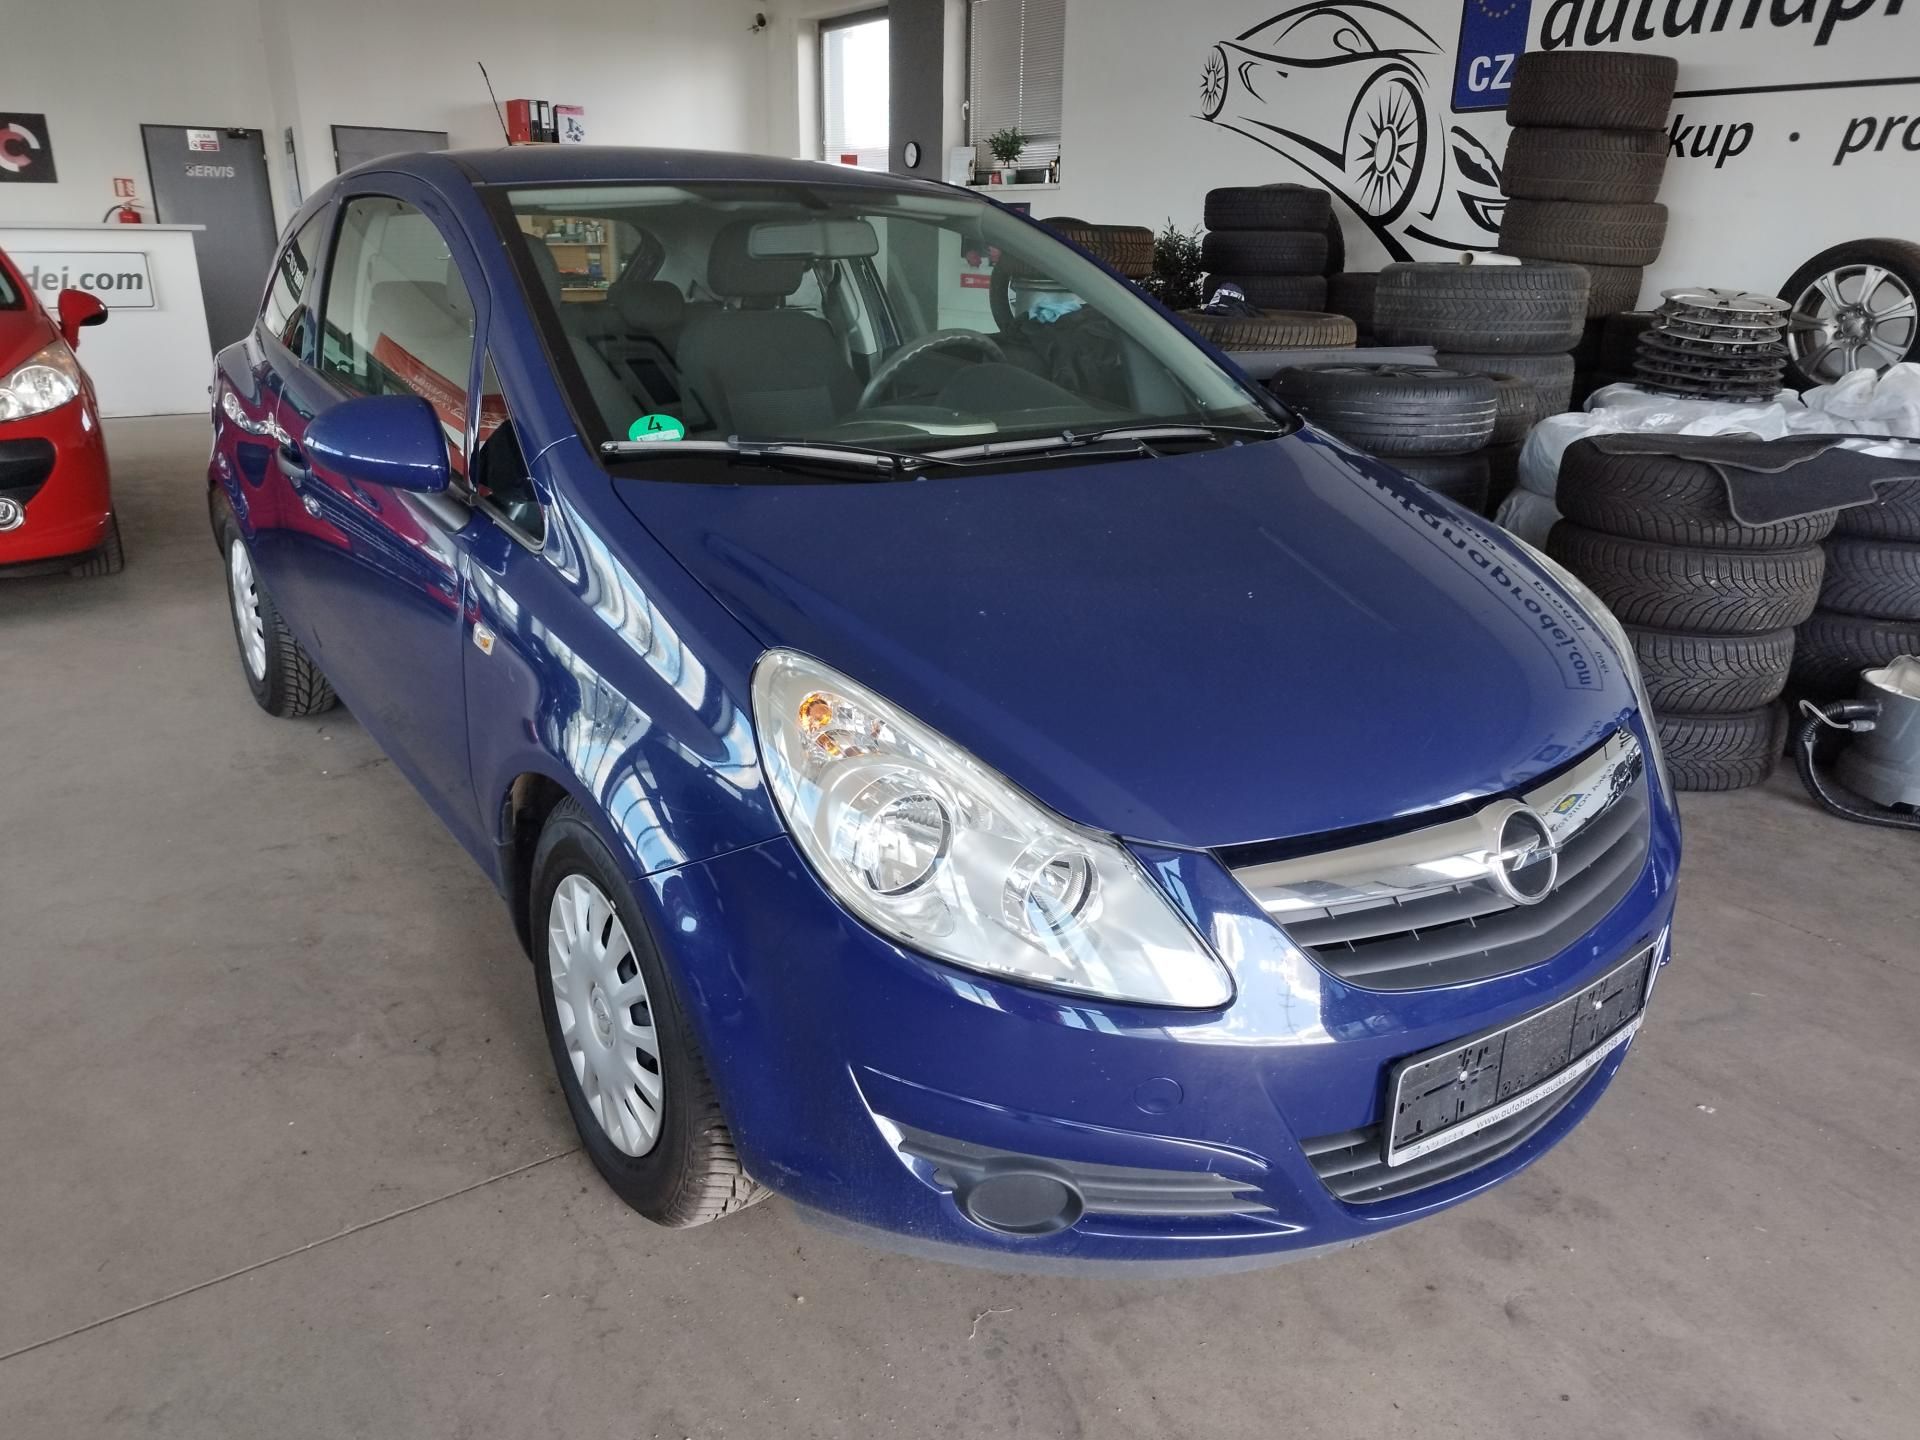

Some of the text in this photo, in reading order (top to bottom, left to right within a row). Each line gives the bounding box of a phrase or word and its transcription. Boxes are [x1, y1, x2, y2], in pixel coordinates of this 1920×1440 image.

[1468, 54, 1512, 92] CZ
[1665, 114, 1755, 169] kup
[186, 165, 235, 178] SERVIS
